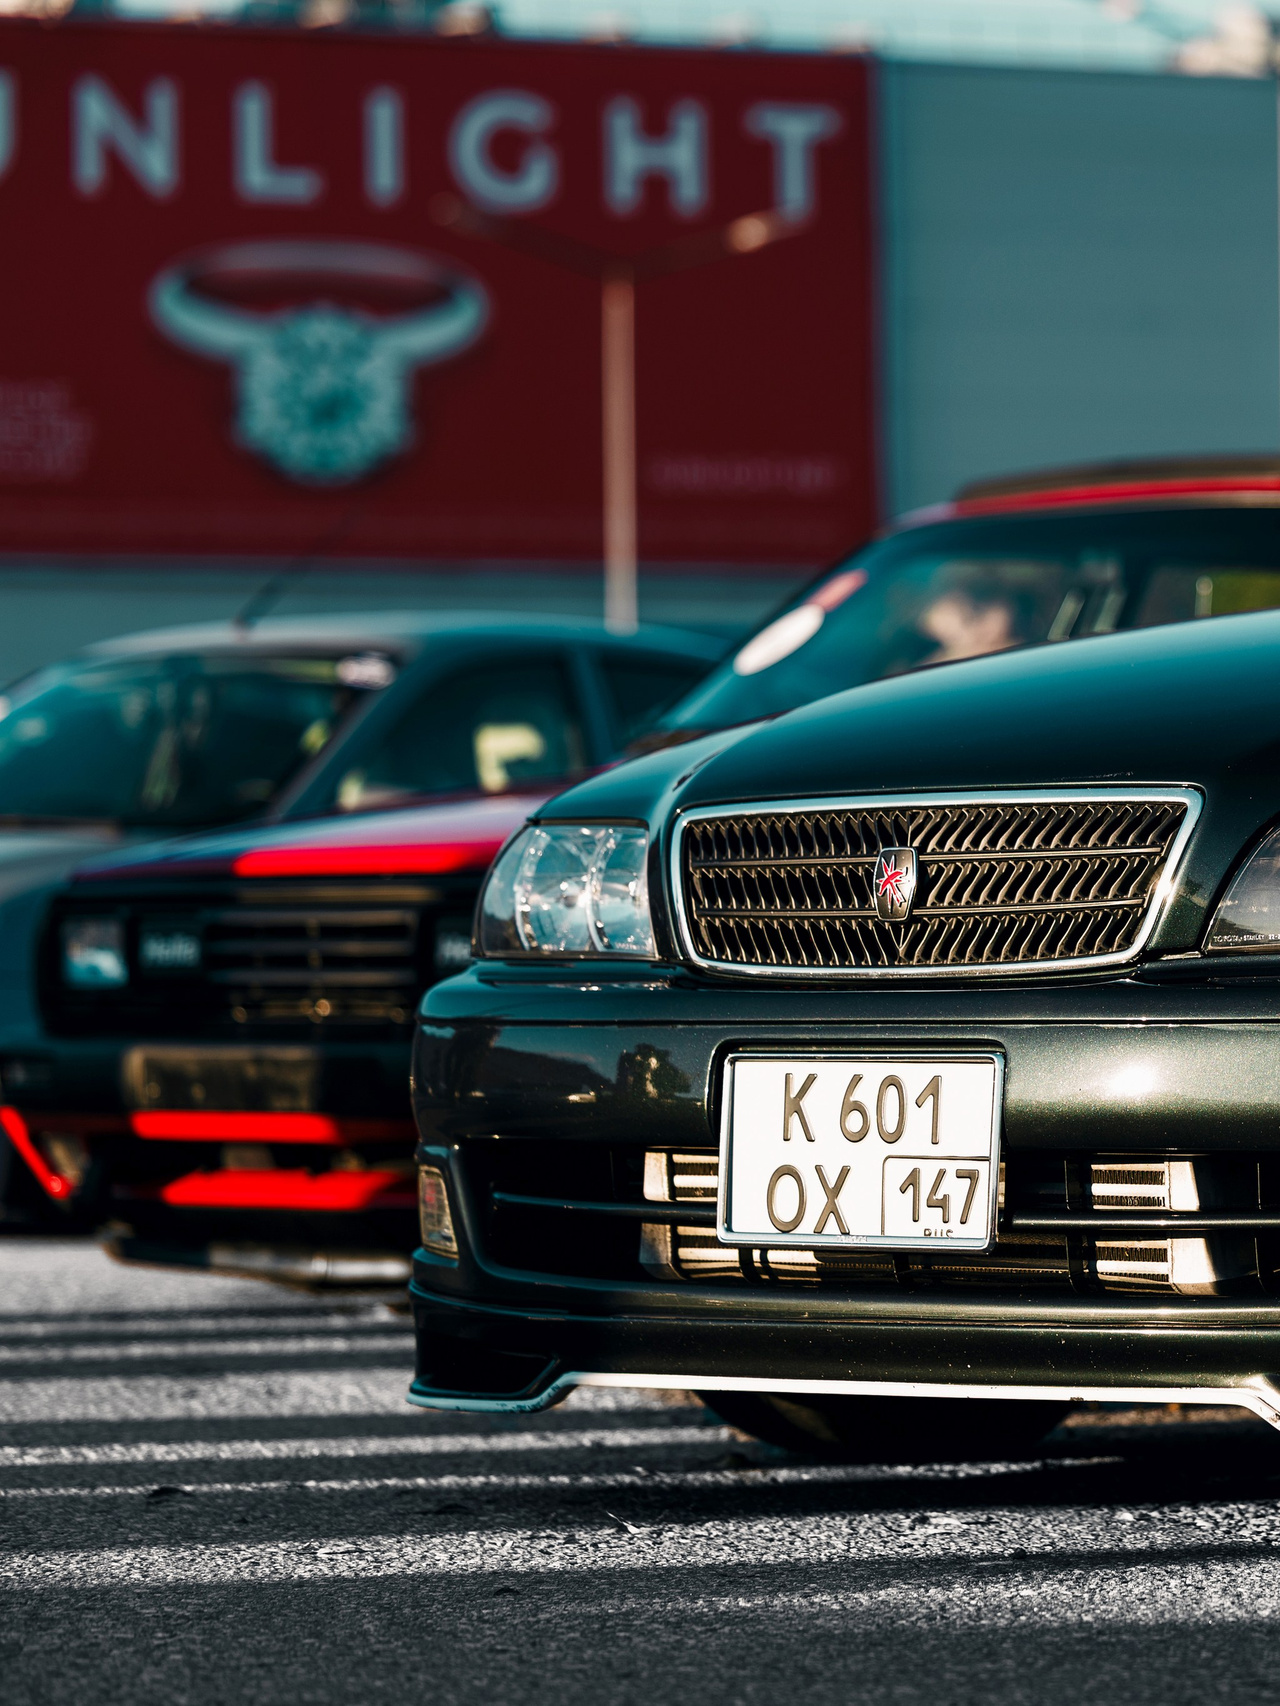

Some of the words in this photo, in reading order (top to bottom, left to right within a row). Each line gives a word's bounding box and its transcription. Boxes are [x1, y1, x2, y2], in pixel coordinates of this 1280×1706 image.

[0, 68, 840, 219] NLIGHT
[839, 1073, 943, 1144] 601
[899, 1167, 980, 1224] 147
